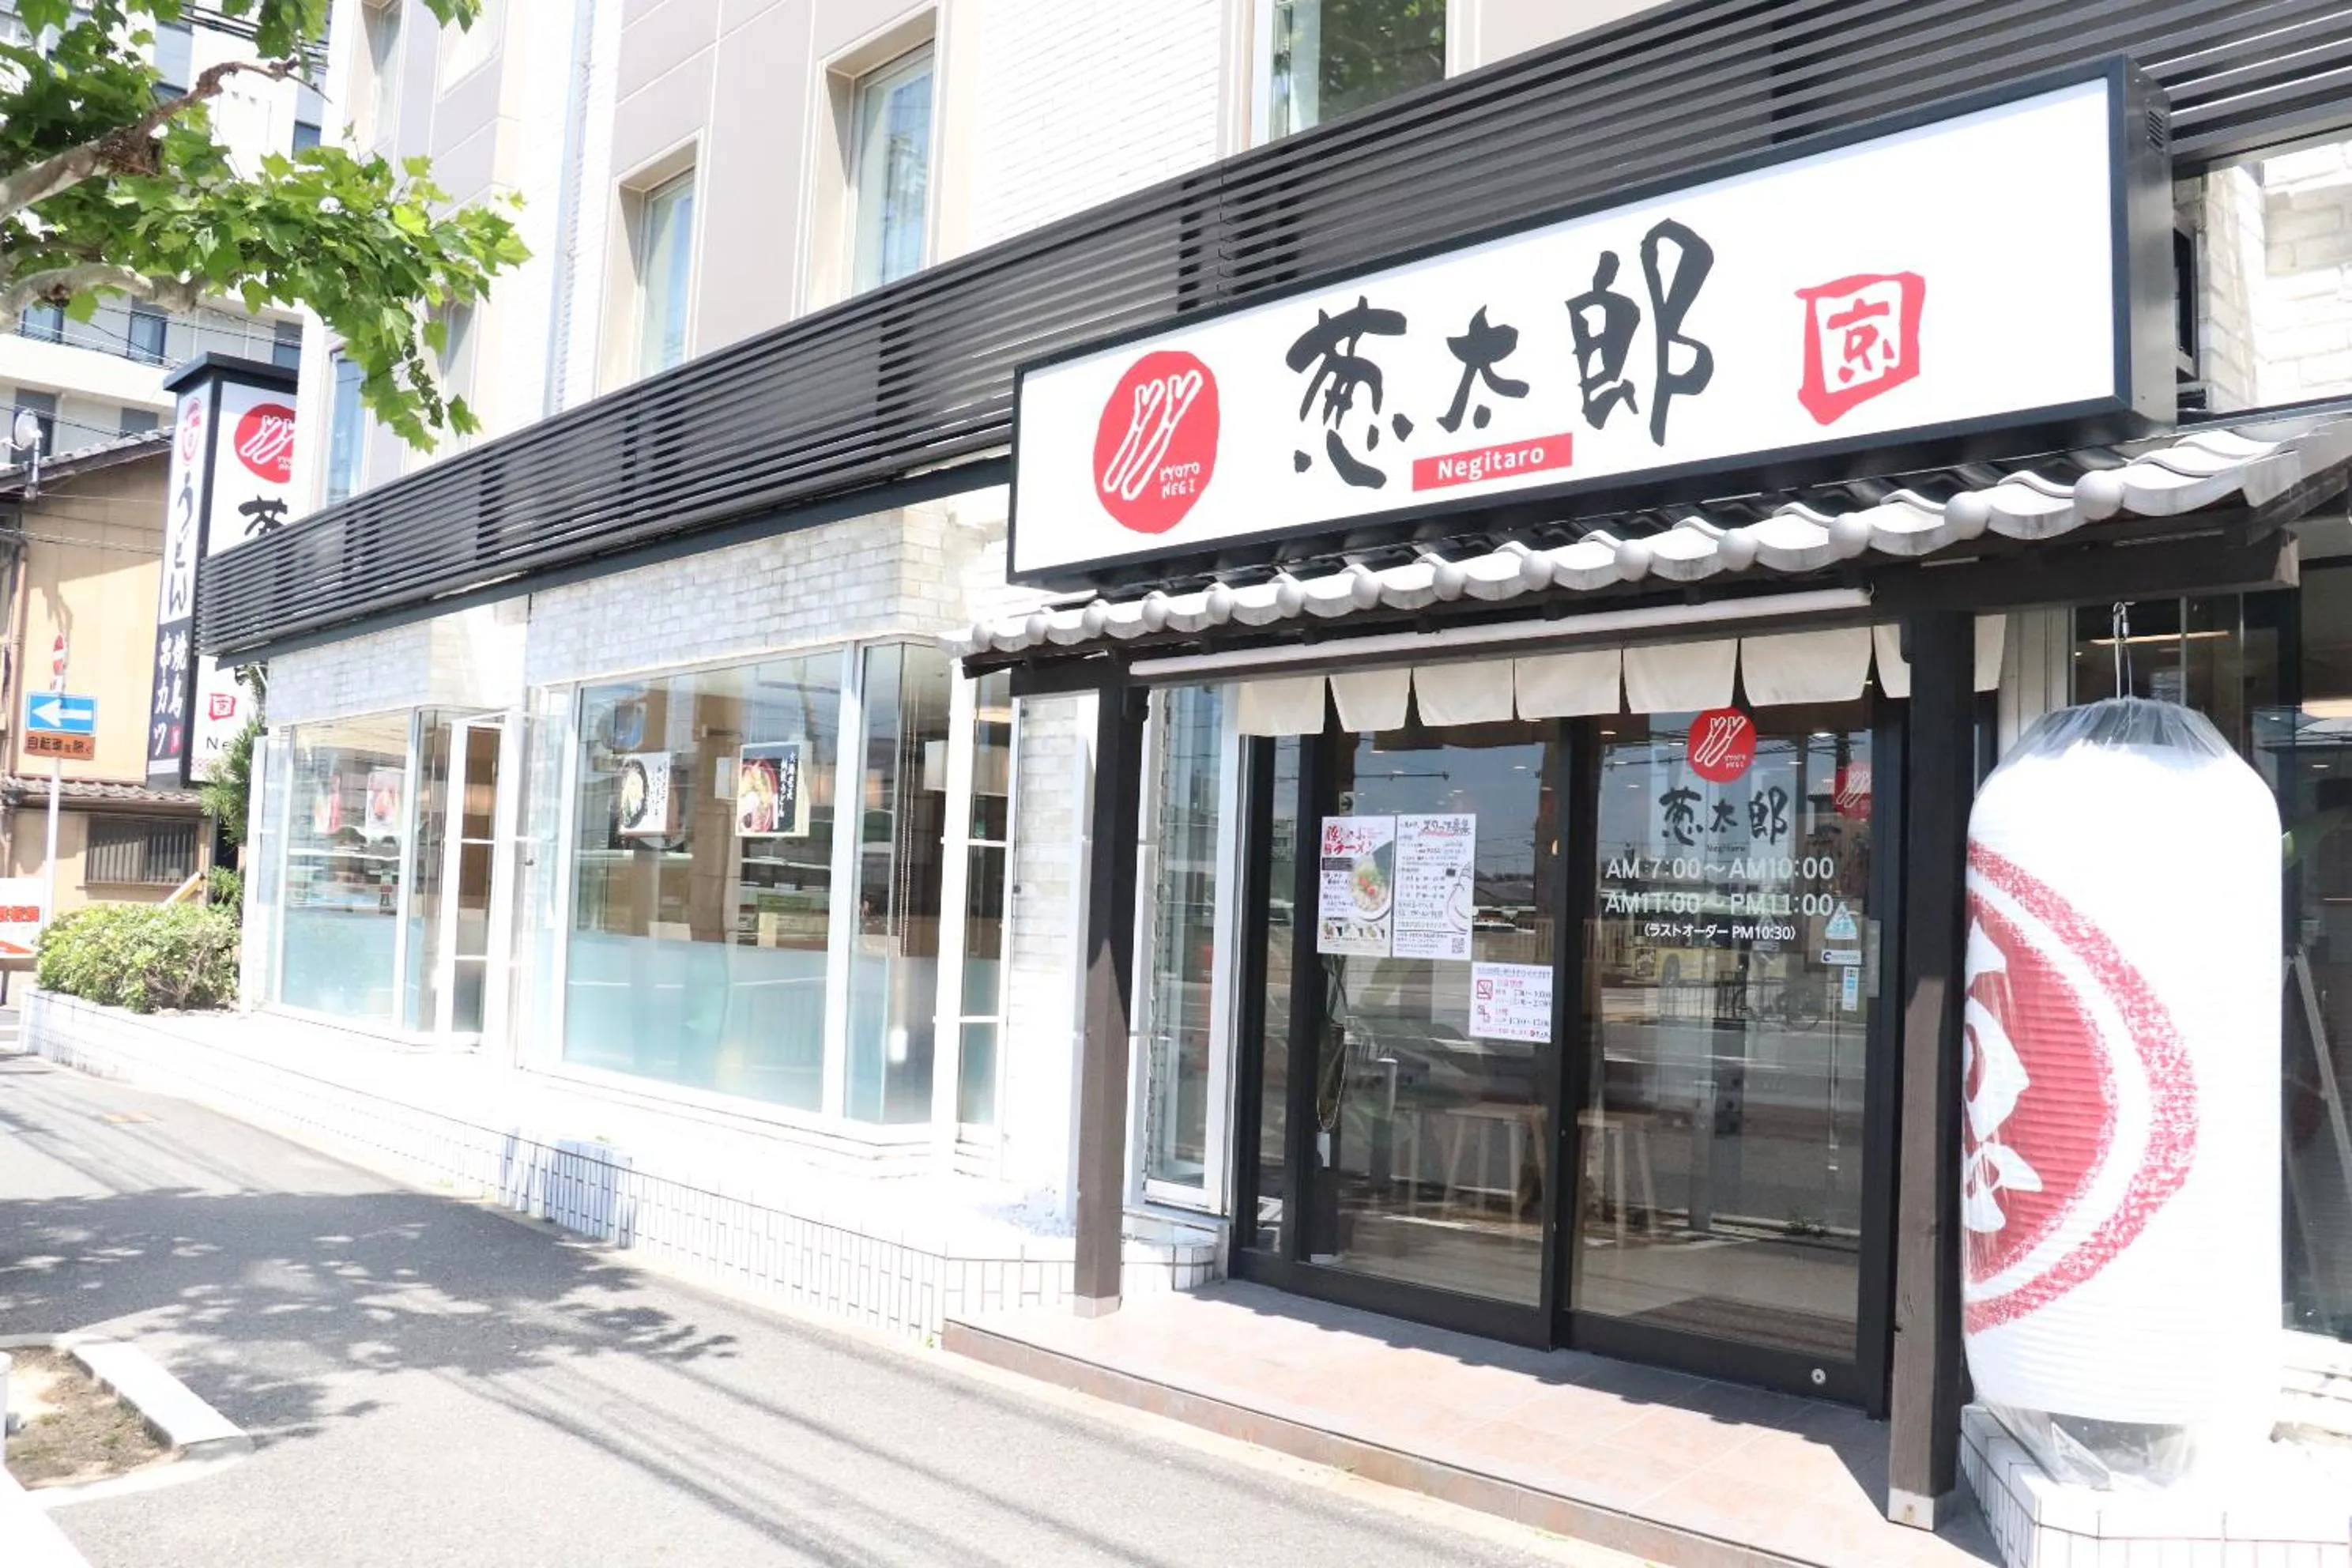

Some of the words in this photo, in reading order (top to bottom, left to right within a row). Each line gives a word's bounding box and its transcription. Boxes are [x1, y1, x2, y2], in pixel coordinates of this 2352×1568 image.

[1285, 217, 1715, 490] 葱太郎
[1437, 446, 1545, 482] Negitaro
[168, 470, 194, 616] うどん
[153, 631, 172, 756] 串カツ
